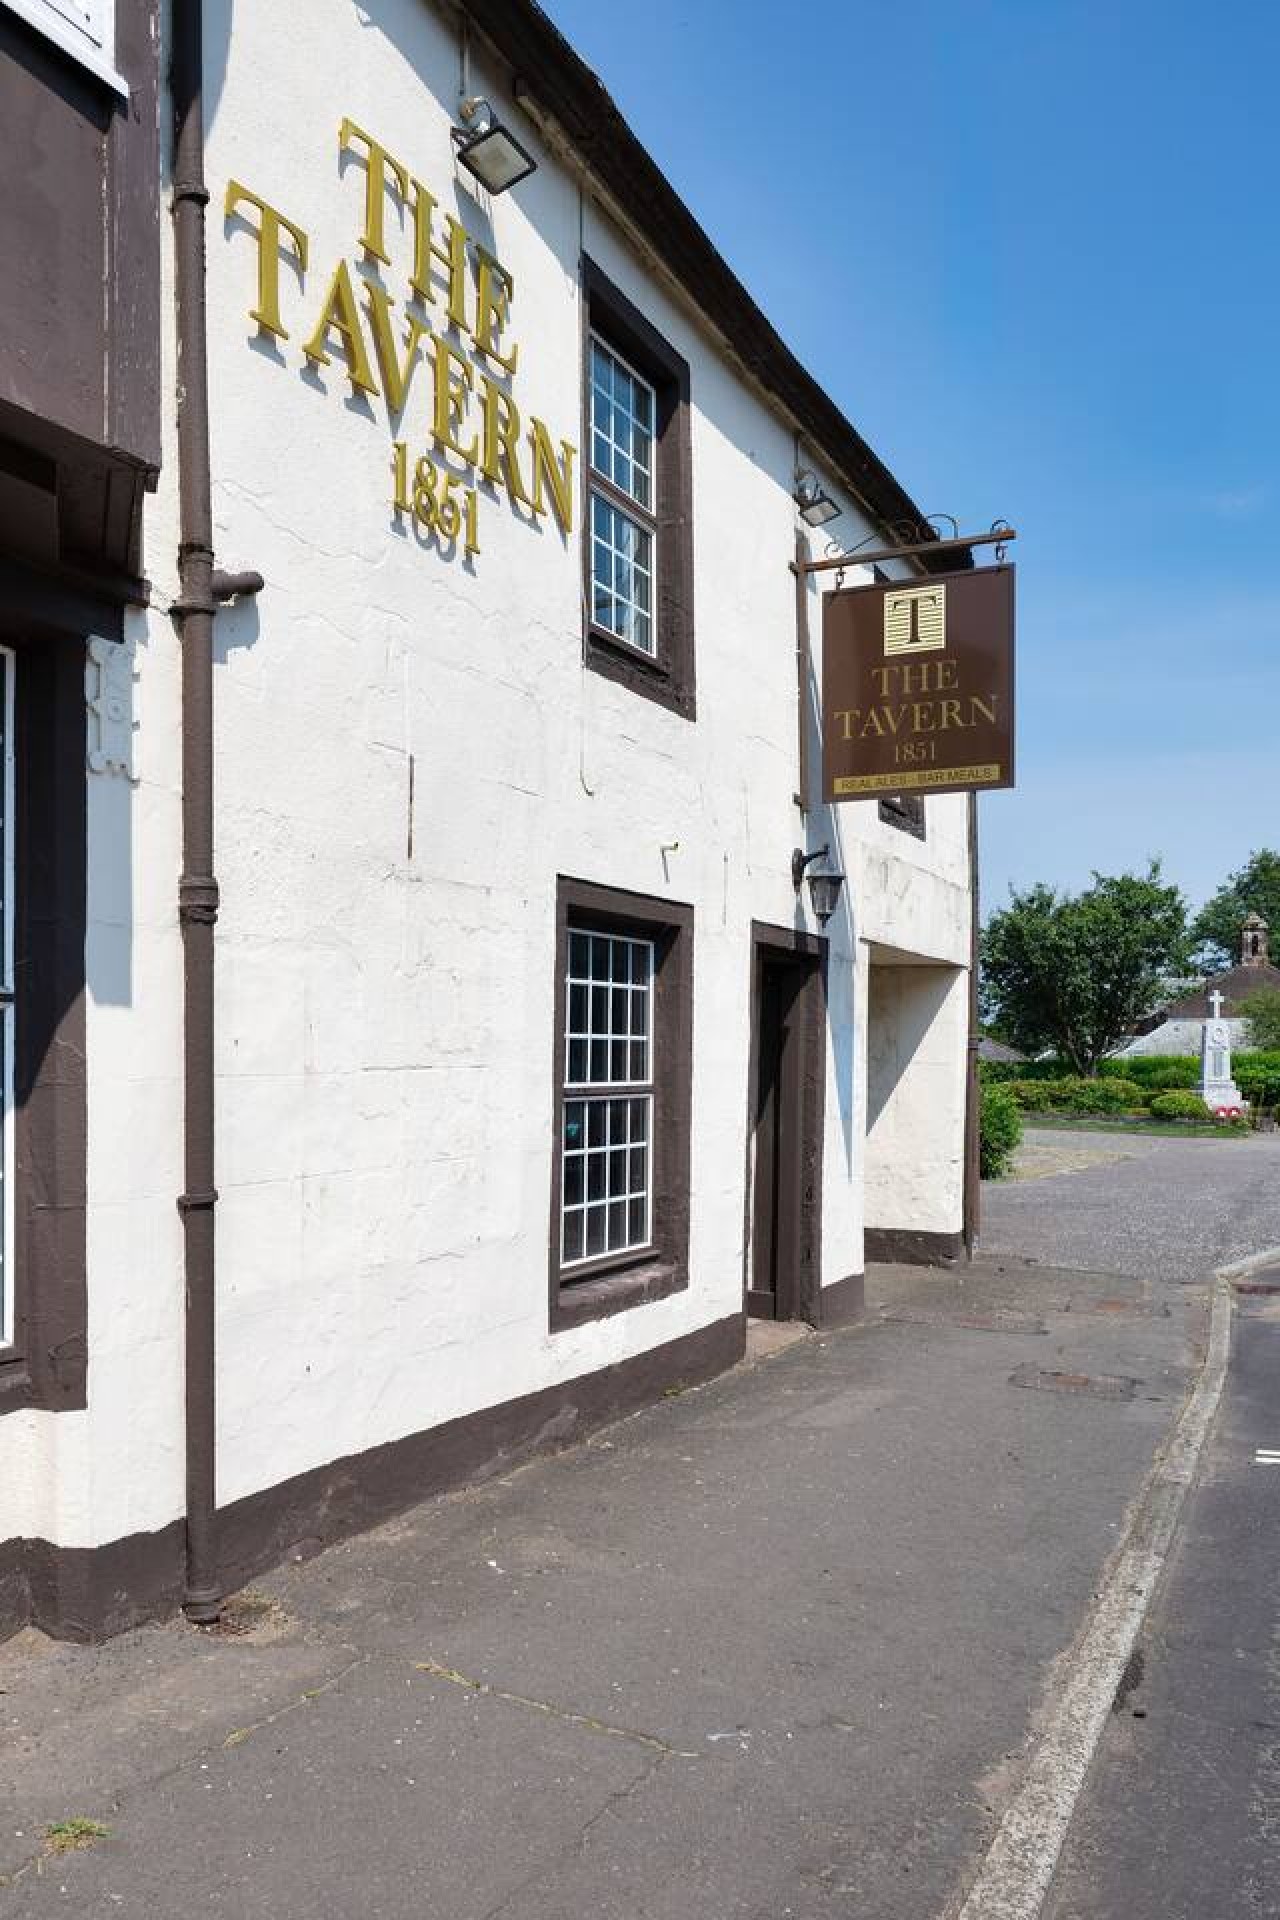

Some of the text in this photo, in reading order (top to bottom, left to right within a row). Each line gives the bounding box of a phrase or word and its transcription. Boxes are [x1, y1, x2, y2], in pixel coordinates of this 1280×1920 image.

[338, 117, 518, 375] THE
[224, 179, 578, 534] TAVERN
[390, 442, 481, 555] 1851
[891, 595, 937, 644] T
[872, 660, 959, 697] THE
[833, 695, 997, 739] TAVERN
[895, 741, 935, 763] 1851
[947, 767, 993, 781] MEALS
